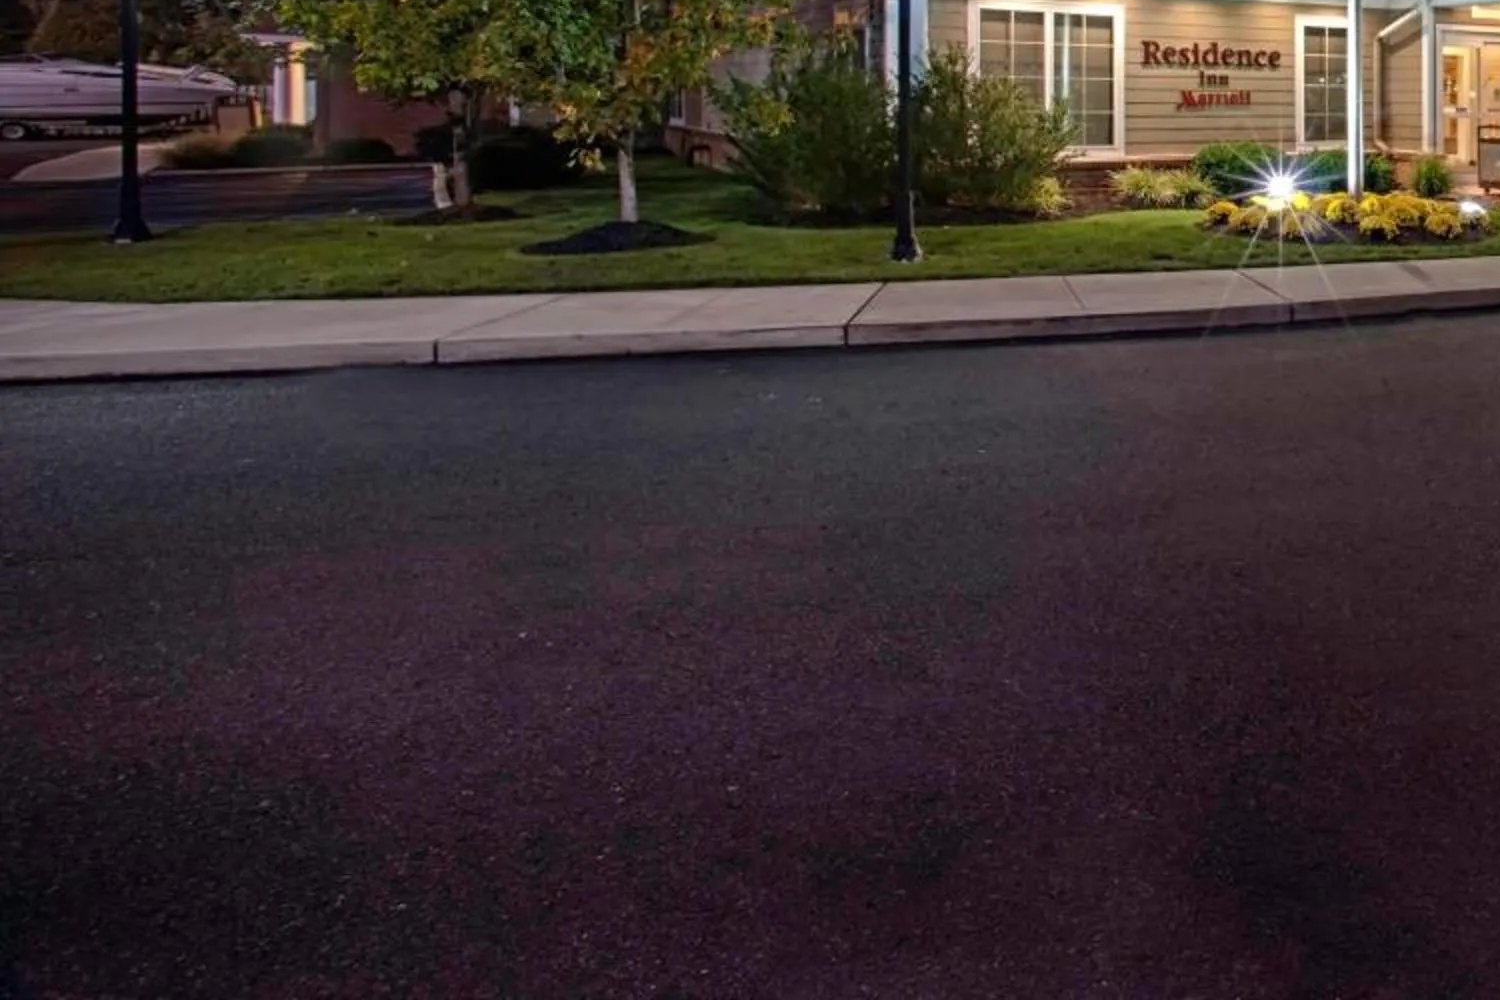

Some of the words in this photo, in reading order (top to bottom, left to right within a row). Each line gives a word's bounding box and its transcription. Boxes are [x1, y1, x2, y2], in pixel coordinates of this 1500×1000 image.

[1141, 40, 1281, 69] Residence
[1199, 70, 1229, 86] Inn
[1176, 90, 1251, 111] Marriott
